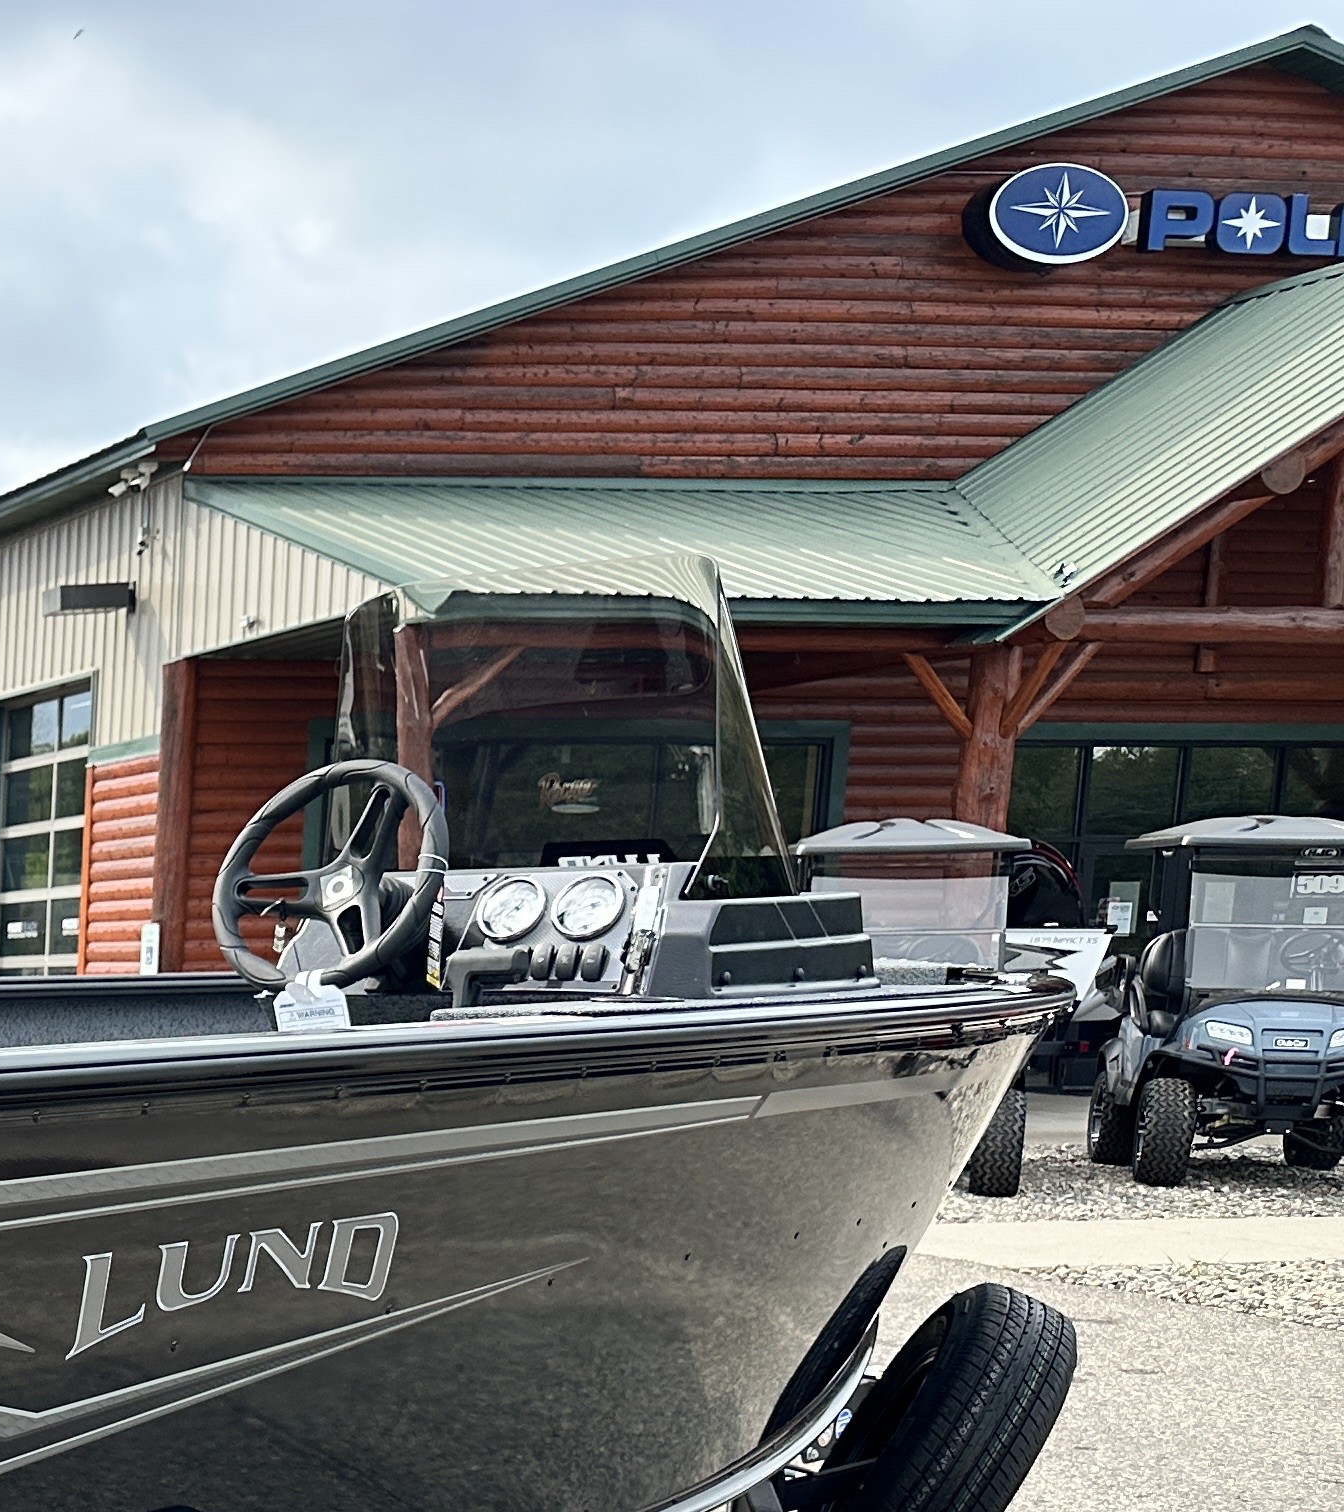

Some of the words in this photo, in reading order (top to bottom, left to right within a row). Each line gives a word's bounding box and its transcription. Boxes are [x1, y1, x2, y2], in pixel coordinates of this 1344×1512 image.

[1142, 189, 1344, 256] POL
[297, 1007, 336, 1020] WARNING
[65, 1212, 401, 1361] LUND
